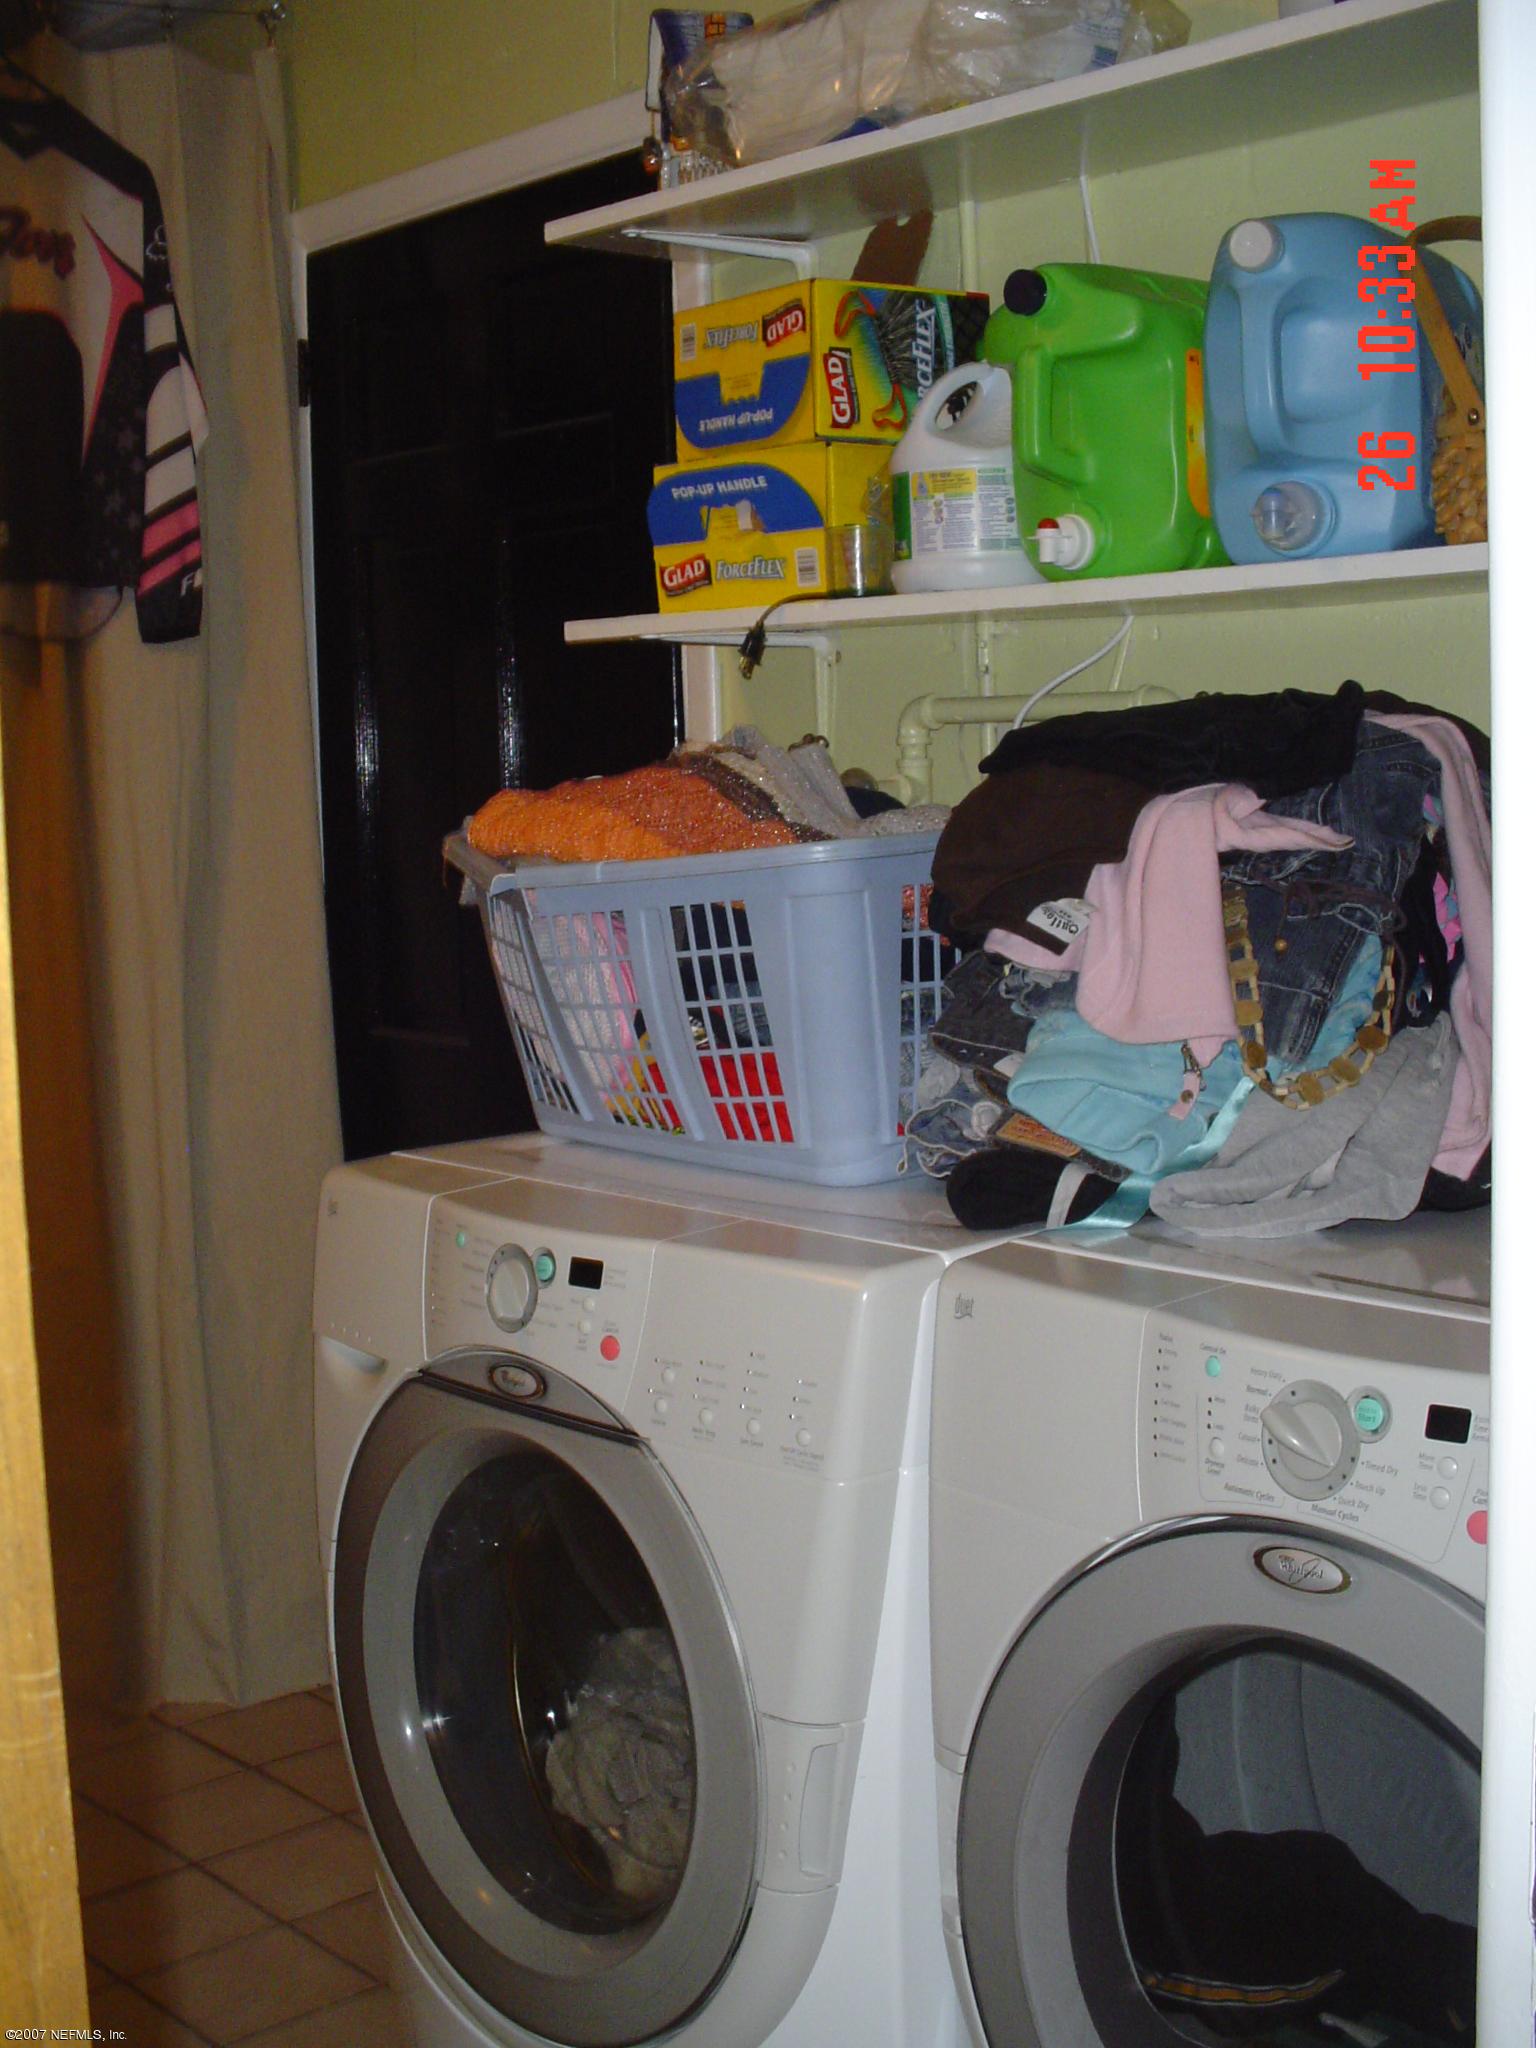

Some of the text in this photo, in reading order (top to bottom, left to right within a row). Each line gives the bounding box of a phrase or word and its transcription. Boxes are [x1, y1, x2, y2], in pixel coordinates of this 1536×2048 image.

[766, 309, 804, 341] GLAD
[828, 356, 850, 424] GLAD
[699, 408, 774, 432] POP-UP HANDLE
[671, 475, 768, 499] POP-UP HANDLE
[663, 559, 705, 588] GLAD
[1386, 1465, 1399, 1477] Dry
